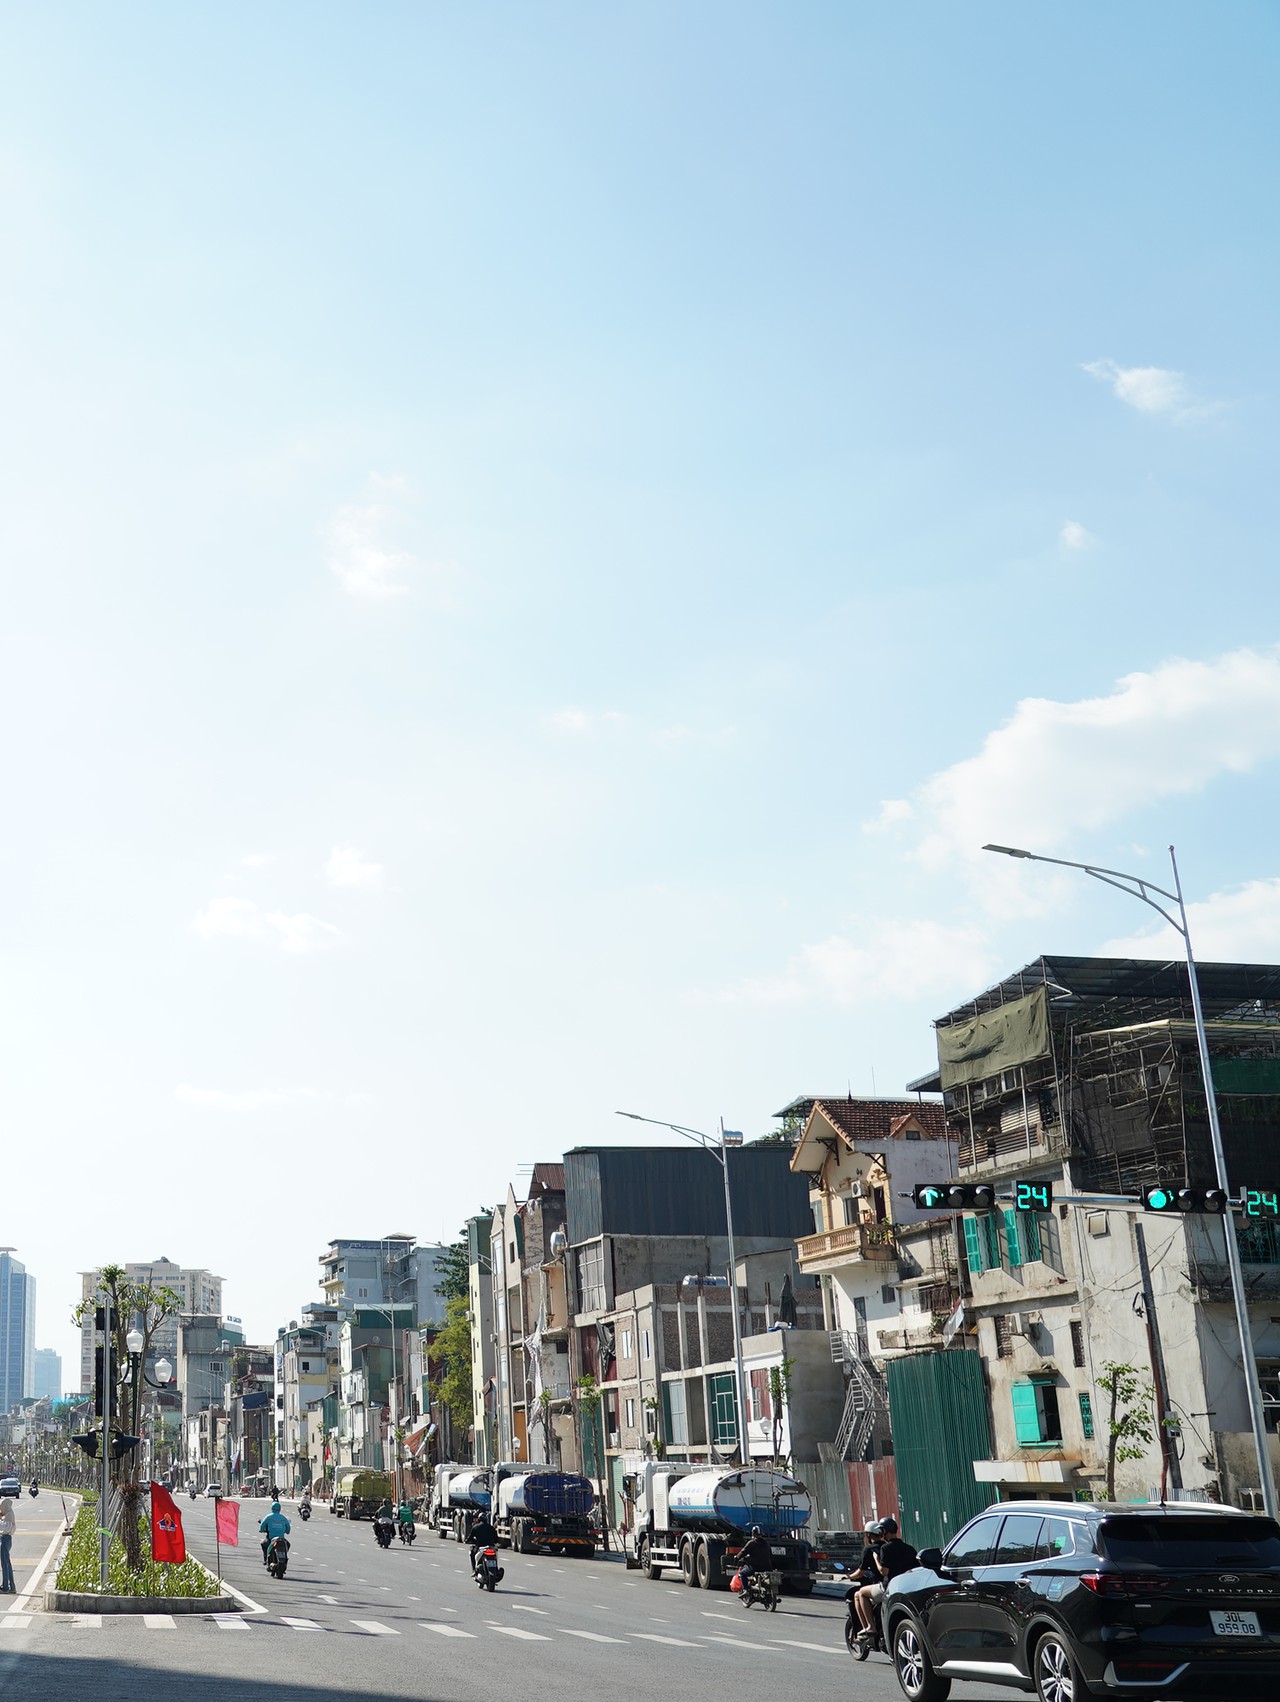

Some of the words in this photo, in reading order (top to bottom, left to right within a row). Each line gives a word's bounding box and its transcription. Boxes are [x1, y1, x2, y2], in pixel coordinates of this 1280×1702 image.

[1017, 1184, 1048, 1209] 24
[1246, 1190, 1279, 1216] 24
[1223, 1612, 1246, 1623] 30L
[1218, 1623, 1257, 1634] 959.08
